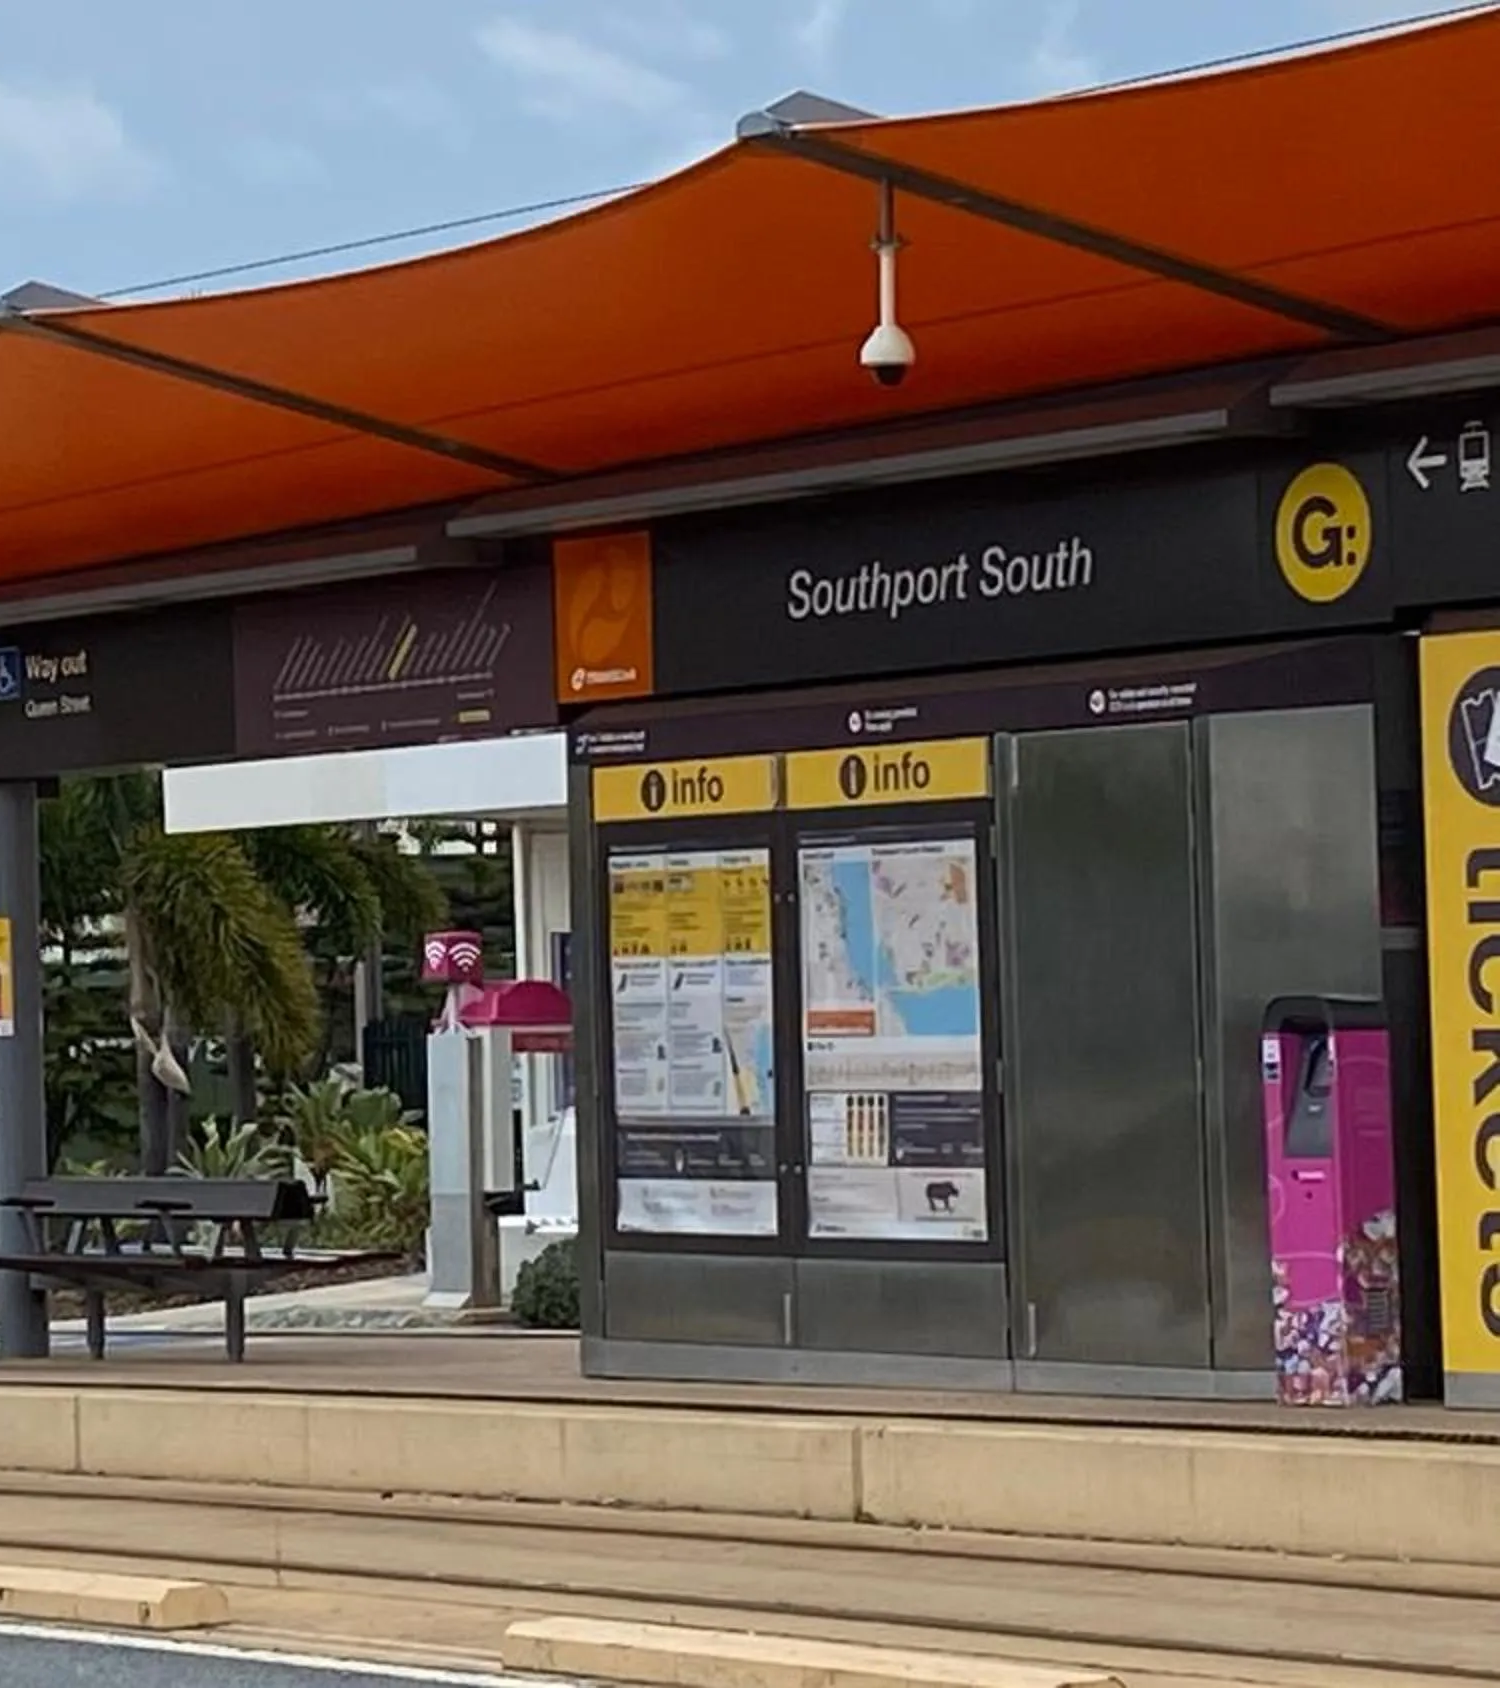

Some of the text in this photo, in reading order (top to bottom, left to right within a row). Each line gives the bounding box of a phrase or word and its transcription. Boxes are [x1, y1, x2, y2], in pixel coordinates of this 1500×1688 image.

[787, 537, 1093, 619] Southport South
[25, 649, 88, 684] Way out
[671, 766, 724, 805] info
[873, 751, 930, 793] info
